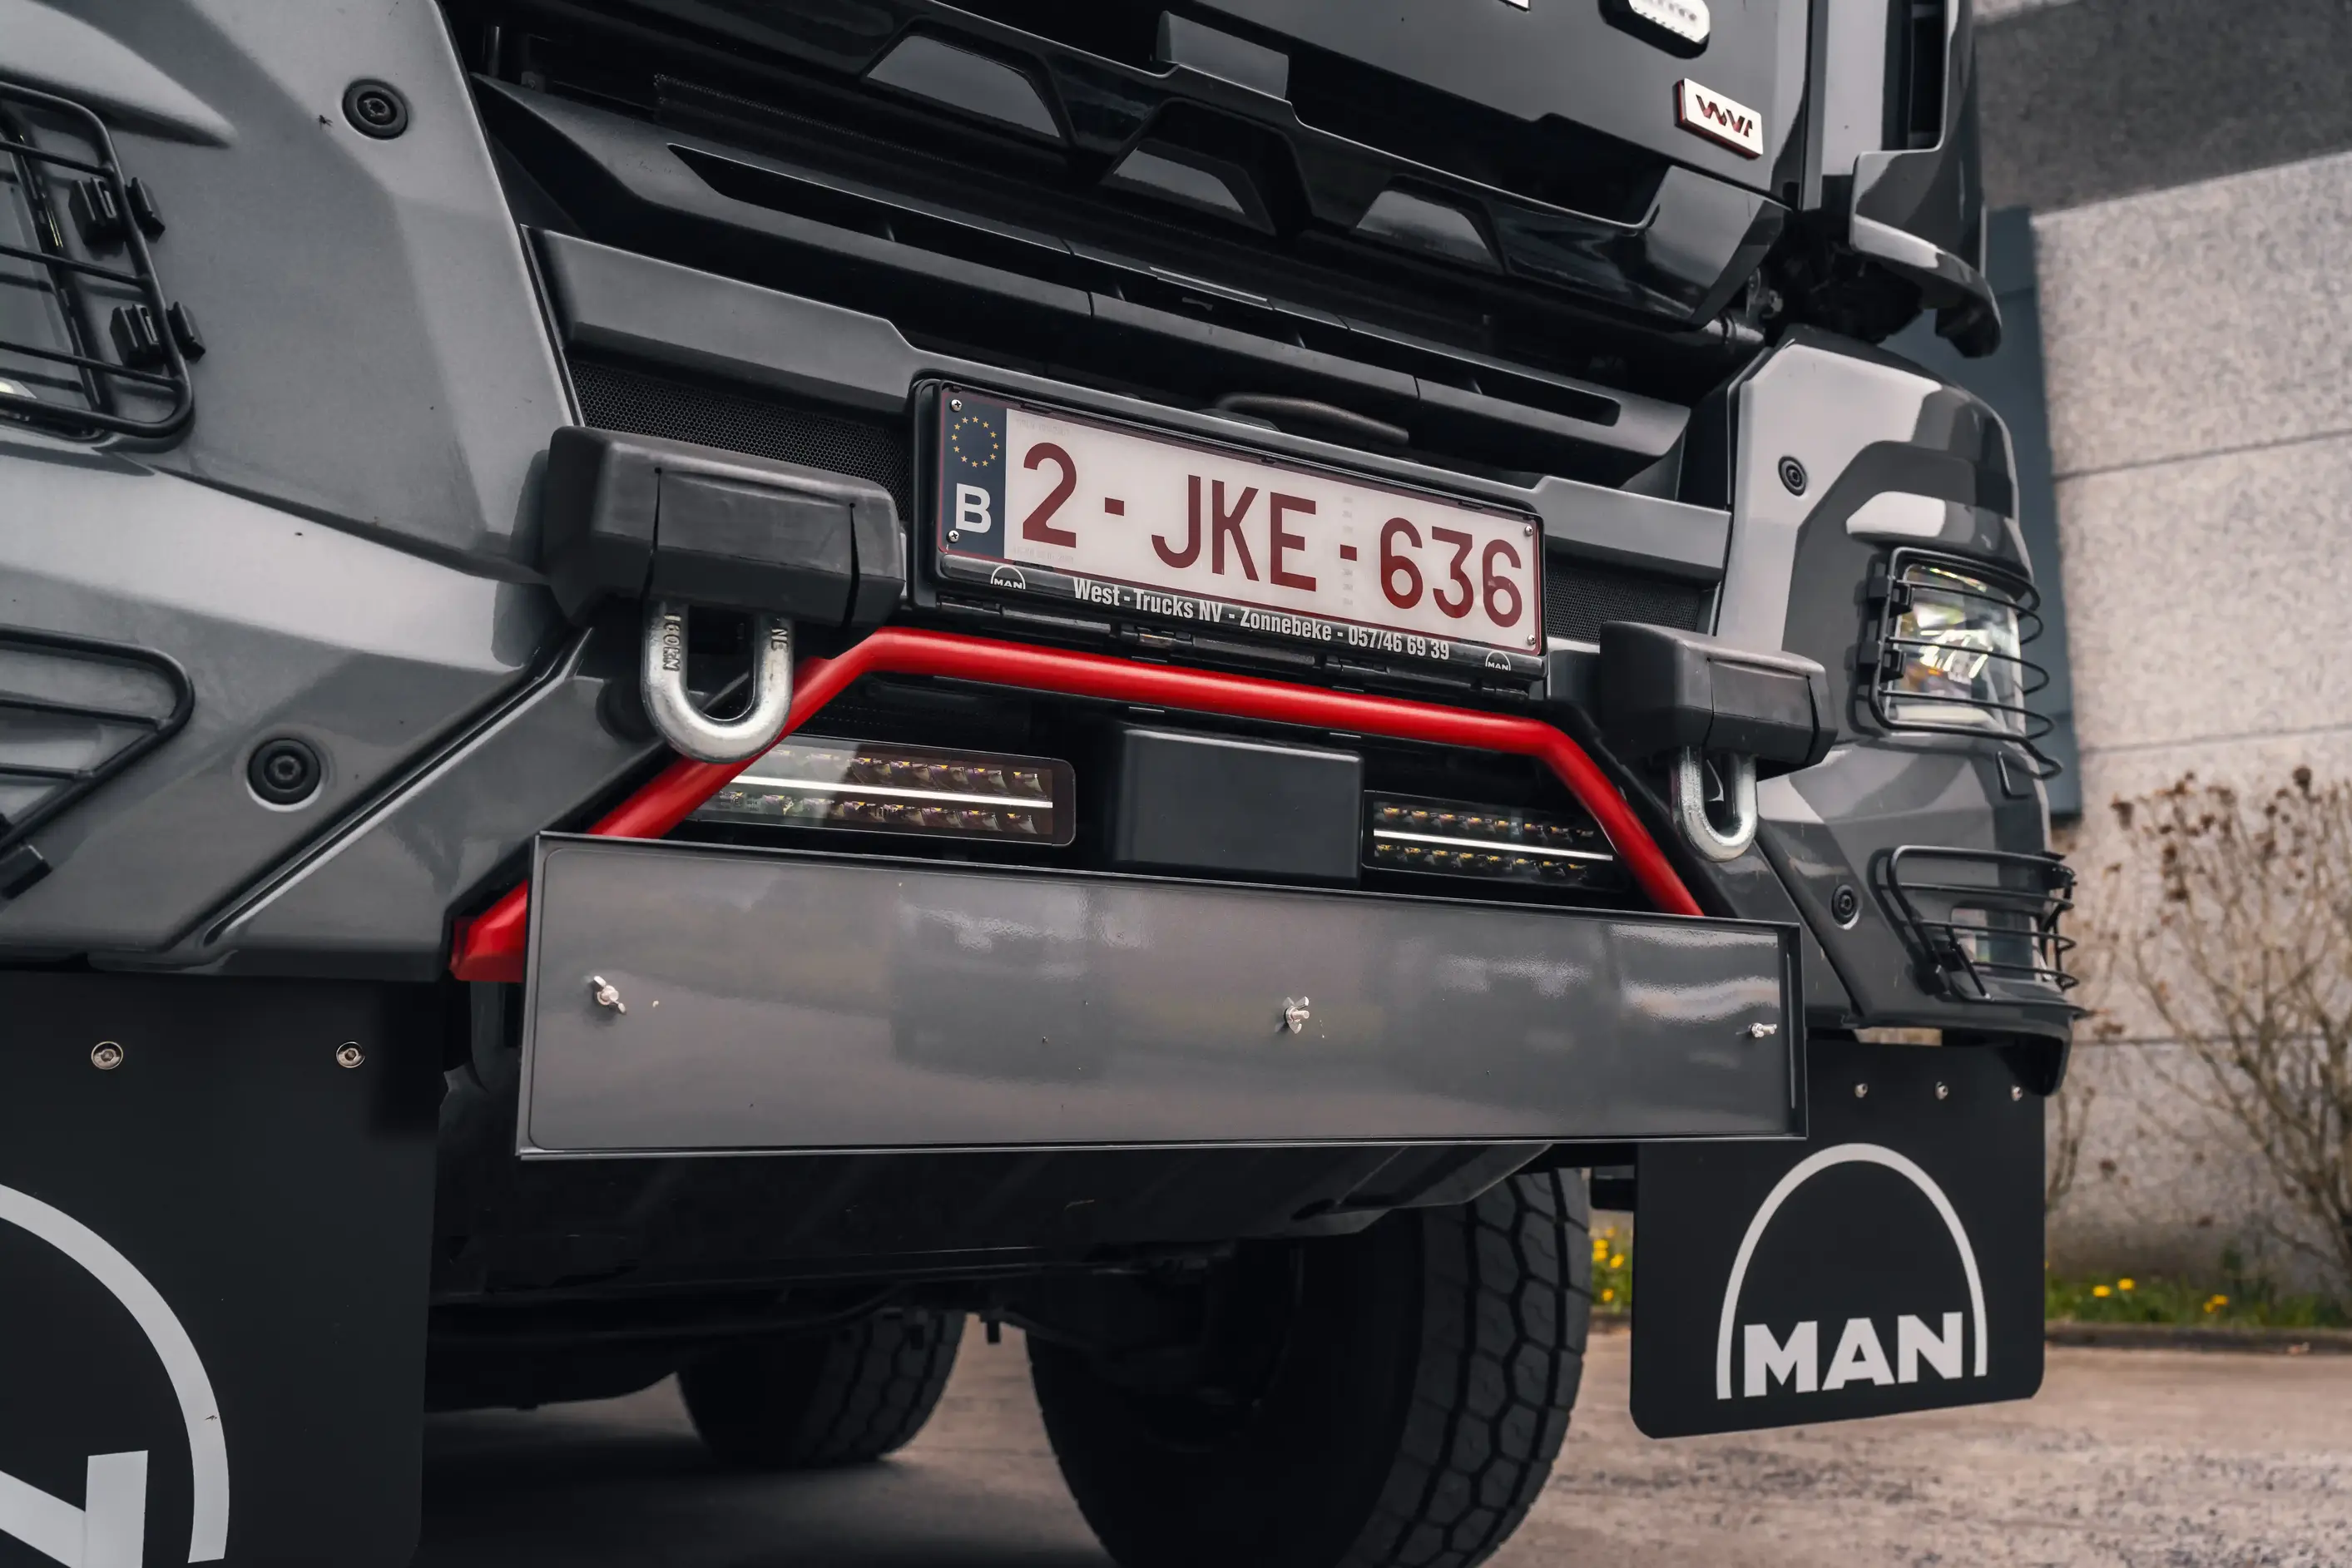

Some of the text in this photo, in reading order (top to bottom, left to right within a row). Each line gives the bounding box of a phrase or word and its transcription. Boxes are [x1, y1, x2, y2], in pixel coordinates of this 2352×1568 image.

[955, 482, 992, 534] B
[993, 578, 1023, 590] MAN
[1073, 577, 1120, 606] West
[1132, 588, 1194, 619] Trucks
[1199, 600, 1223, 623] NV
[1240, 606, 1332, 641] Zonnebeke
[1348, 625, 1403, 653] 057/46
[1407, 636, 1426, 656] 69
[1430, 640, 1449, 660] 39
[1488, 661, 1509, 671] MAN
[1744, 1311, 1963, 1397] MAN
